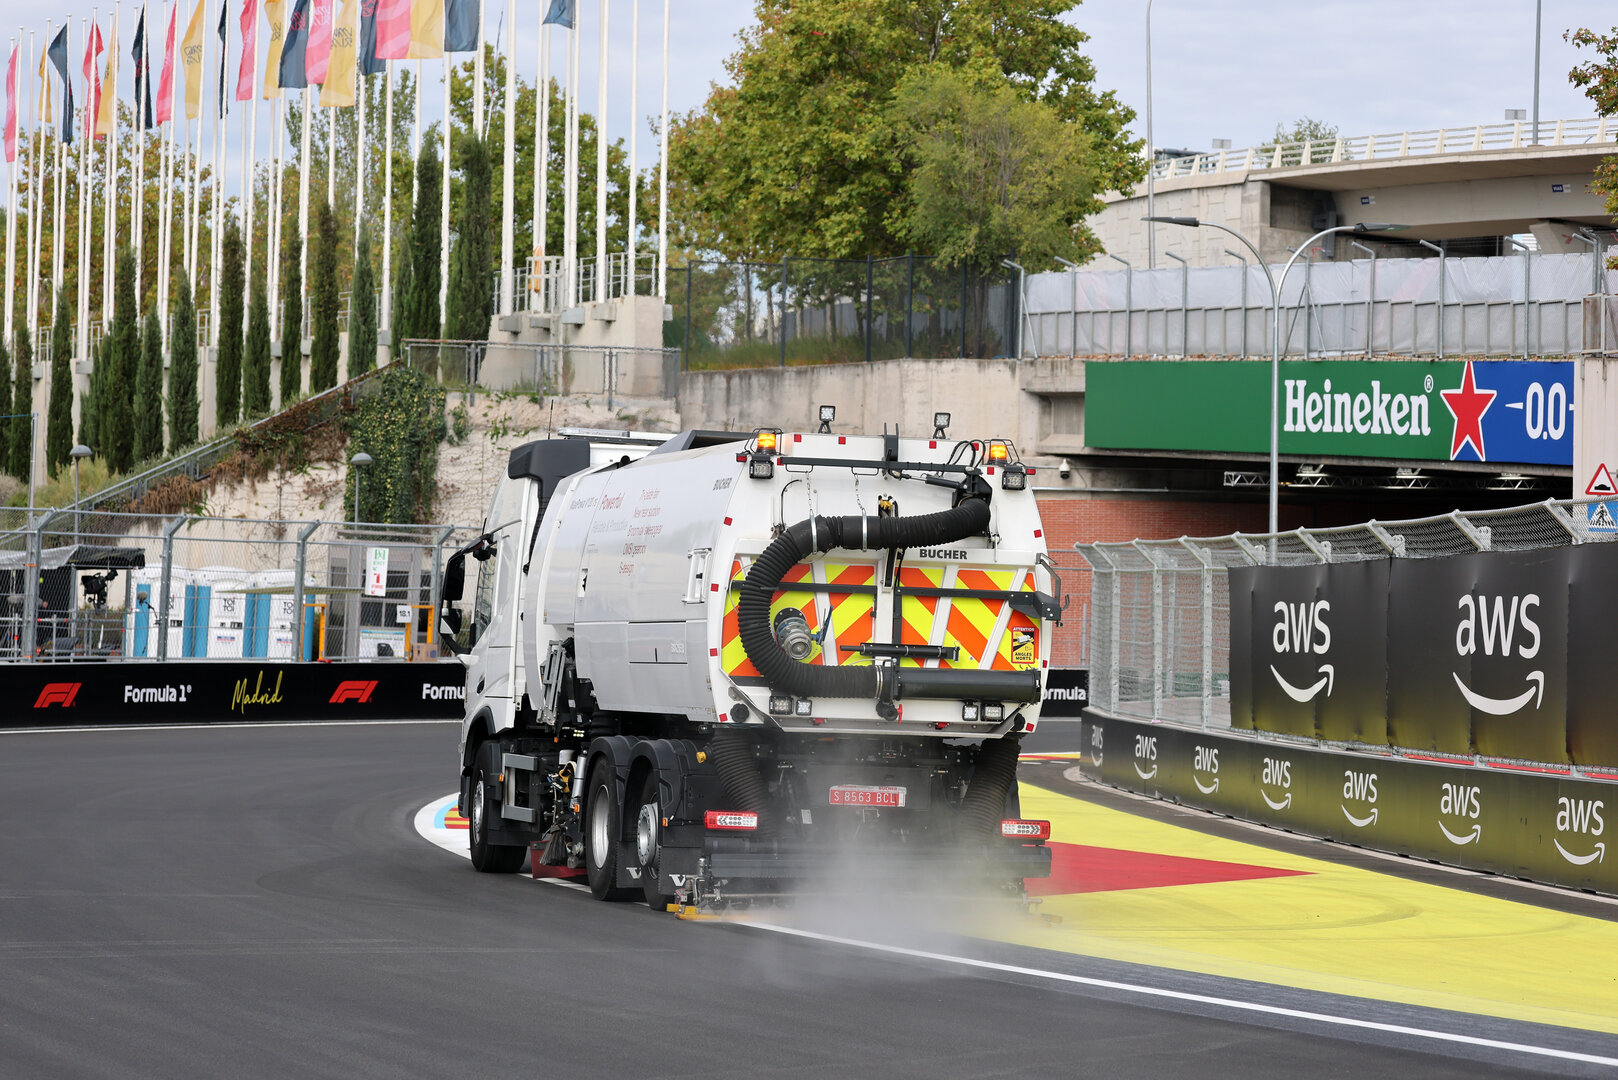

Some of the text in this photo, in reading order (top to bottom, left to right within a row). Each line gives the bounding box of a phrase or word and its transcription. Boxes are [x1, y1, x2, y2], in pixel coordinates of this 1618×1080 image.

[712, 477, 732, 490] BUCHER
[600, 492, 625, 511] Powerful
[919, 549, 968, 560] BUCHER
[1273, 599, 1331, 655] aws
[1456, 593, 1542, 659] aws
[124, 685, 177, 703] Formula
[231, 670, 283, 714] Madrid
[422, 683, 466, 699] Formu
[1043, 686, 1086, 700] ormula
[1135, 734, 1157, 761] aws
[1194, 745, 1219, 774] aws
[1262, 757, 1291, 789] aws
[1343, 770, 1378, 803] aws
[834, 791, 896, 803] S 8563 BCL
[1440, 782, 1481, 819] aws
[1556, 796, 1604, 836] aws
